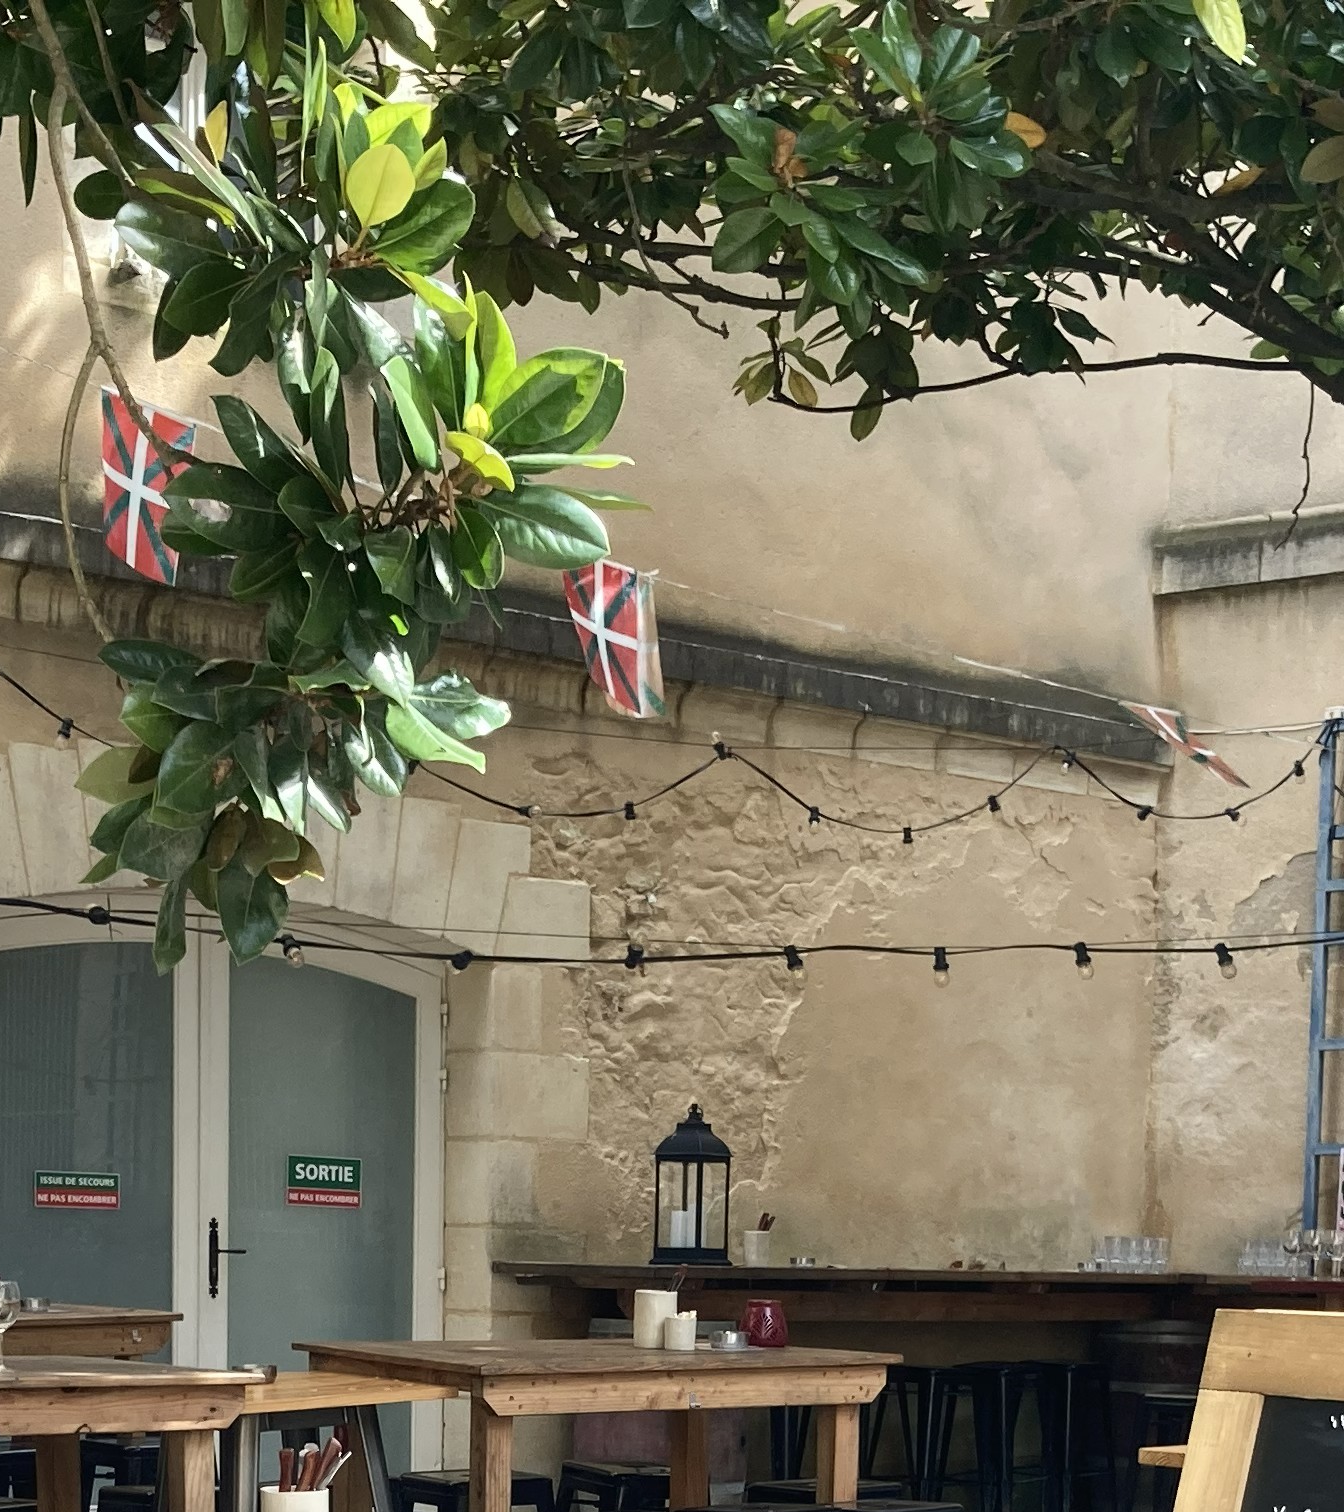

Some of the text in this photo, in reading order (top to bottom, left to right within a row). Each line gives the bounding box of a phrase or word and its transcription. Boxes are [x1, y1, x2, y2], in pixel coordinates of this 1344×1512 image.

[294, 1163, 354, 1183] SORTIE
[39, 1176, 115, 1187] ISSUE DE SECOURS
[37, 1193, 117, 1204] NE PAS ENCOMBRER
[288, 1192, 359, 1204] NE PAS ENCOMBRER
